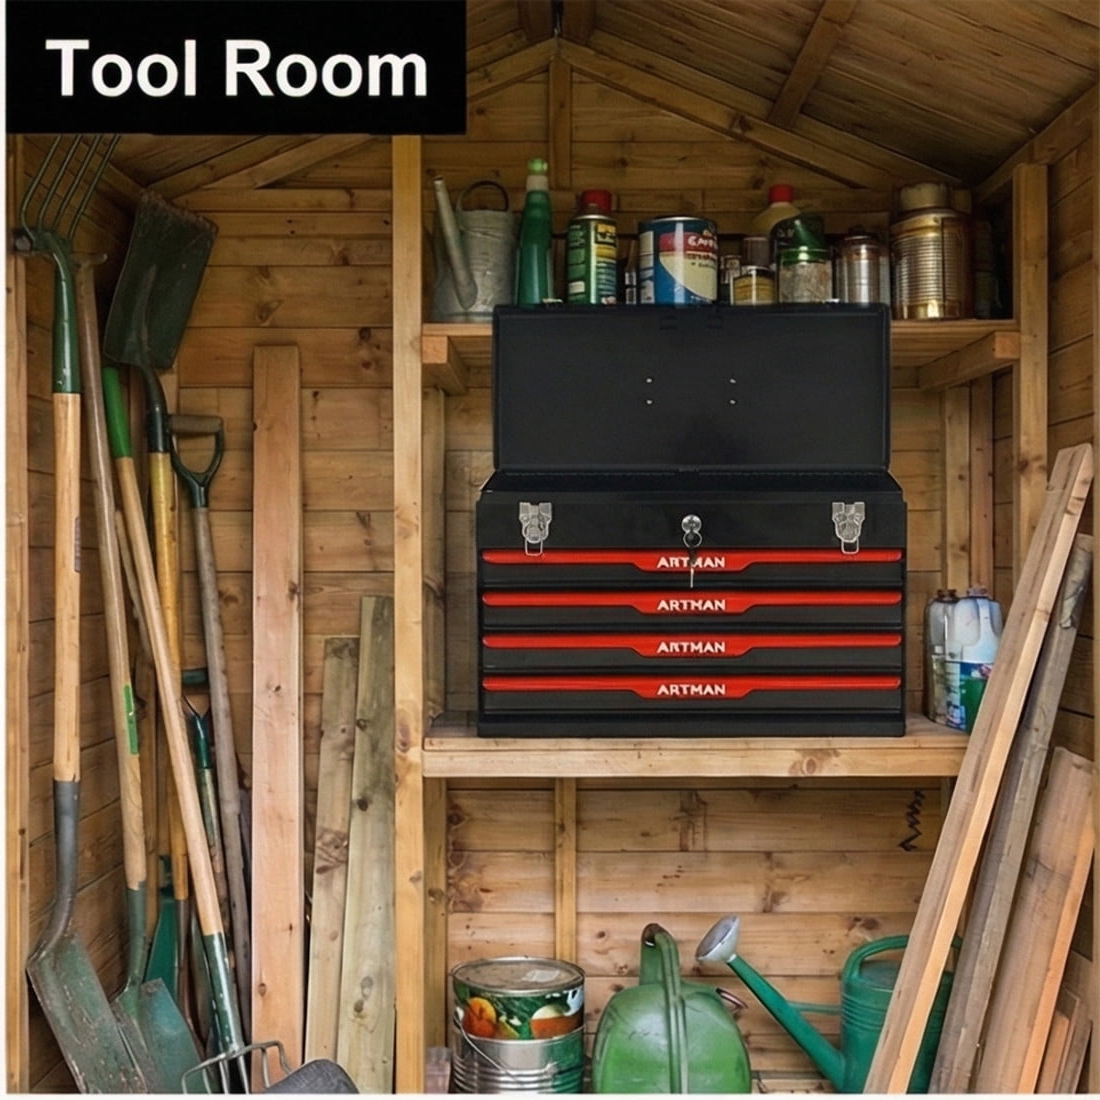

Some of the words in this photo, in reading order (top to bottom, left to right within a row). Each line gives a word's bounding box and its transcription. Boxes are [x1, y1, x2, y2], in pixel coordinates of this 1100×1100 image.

[657, 598, 727, 612] ARTMAN
[657, 640, 727, 654] ARTMAN
[657, 683, 727, 697] ARTMAN
